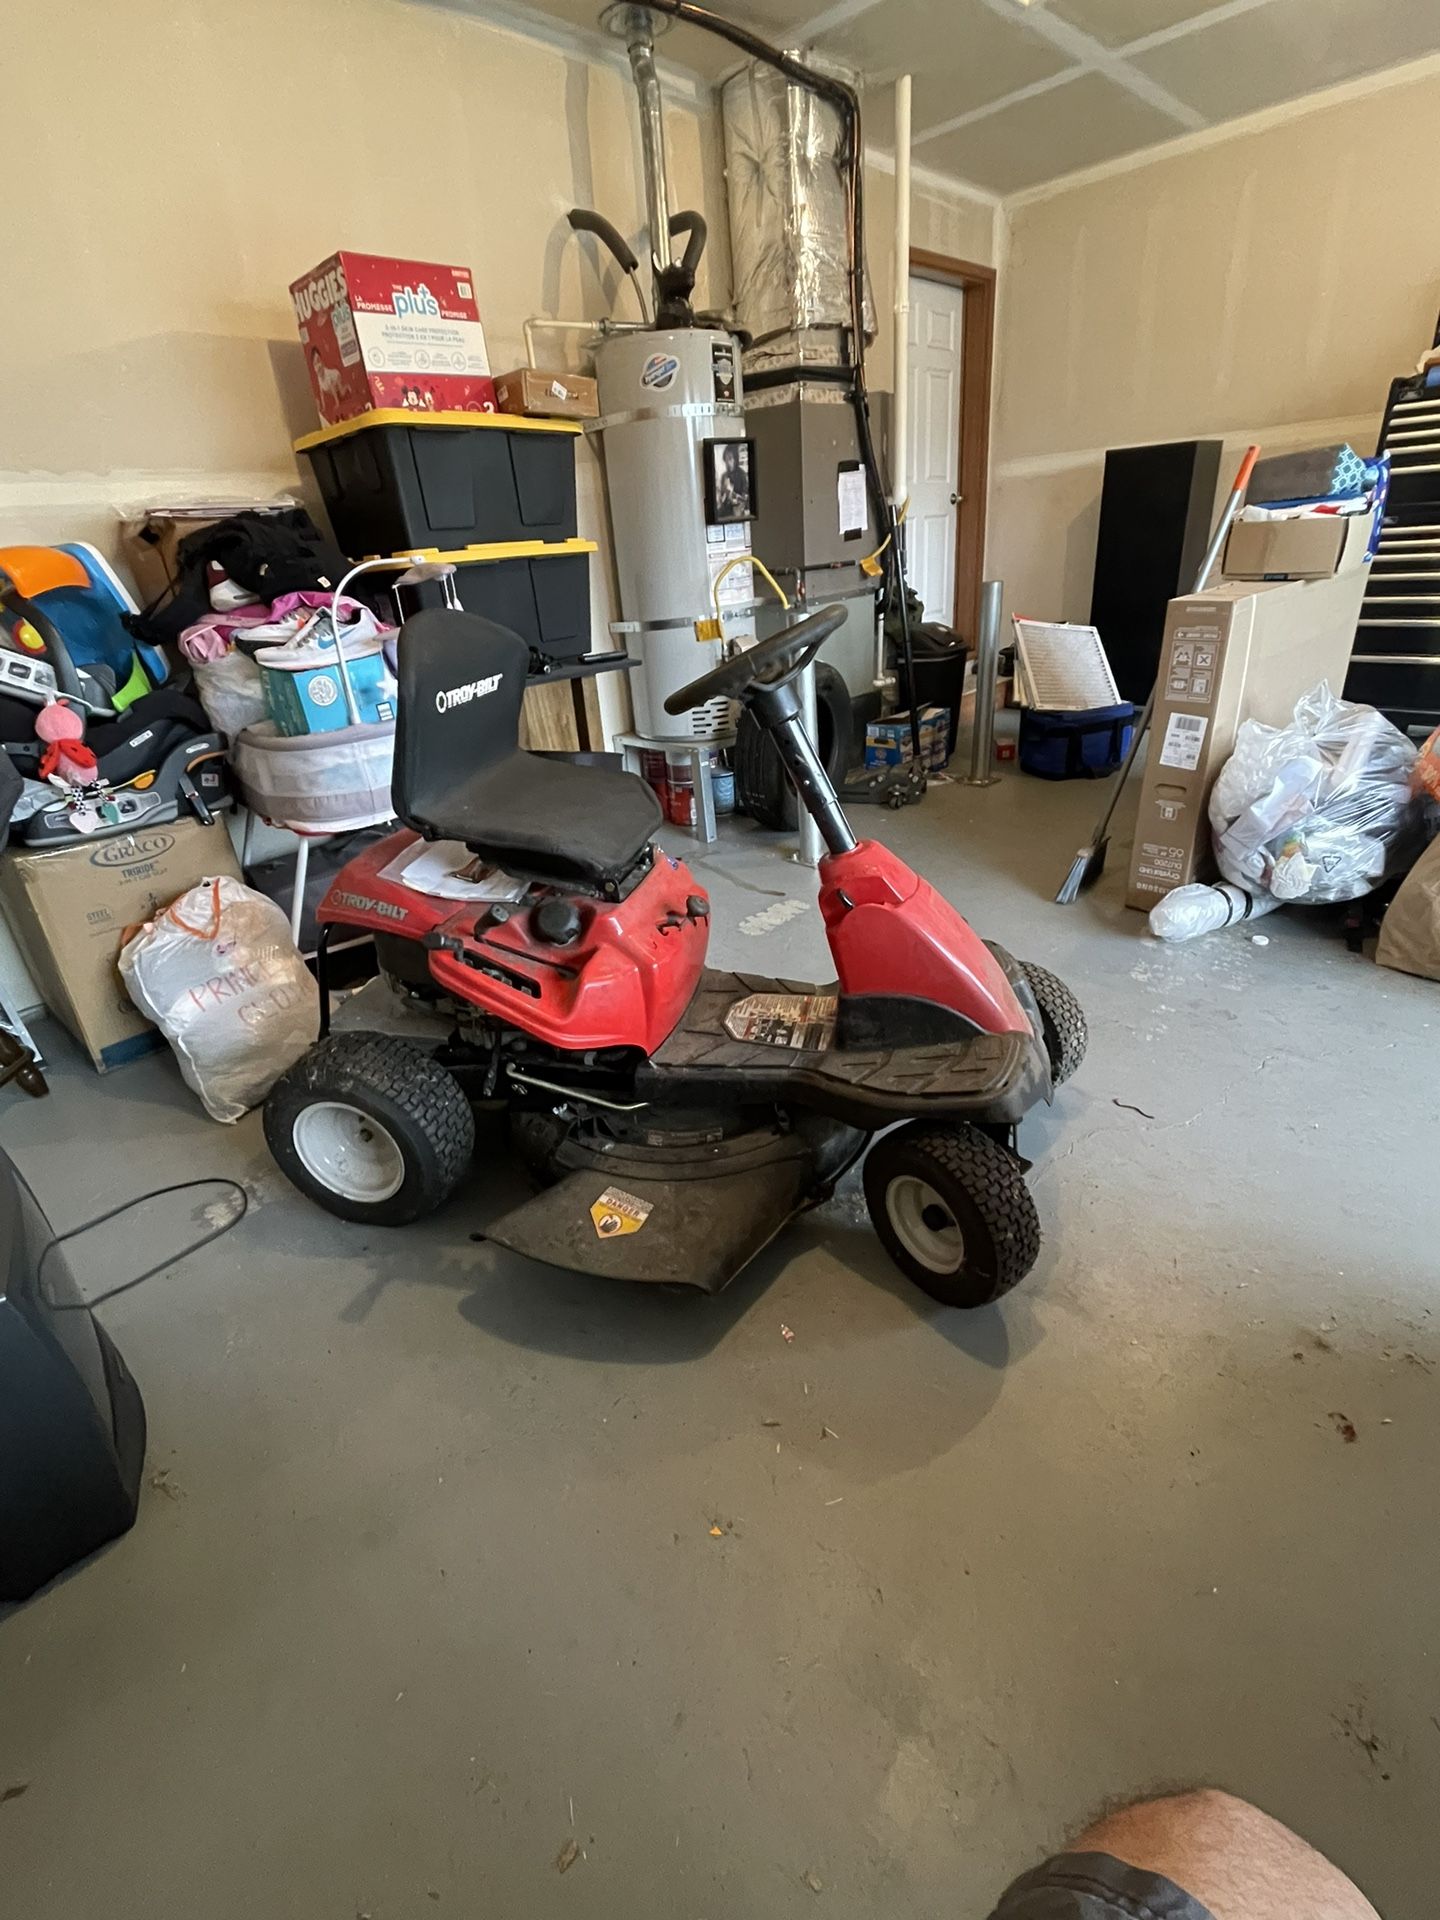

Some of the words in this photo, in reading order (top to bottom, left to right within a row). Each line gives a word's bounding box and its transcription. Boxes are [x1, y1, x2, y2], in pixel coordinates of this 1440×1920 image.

[295, 266, 348, 323] HUGGIES
[357, 302, 394, 313] PROMESSE
[441, 310, 468, 319] PROMISE
[446, 673, 503, 709] TROY-BILT
[103, 836, 167, 862] GRACO
[1168, 847, 1184, 858] 65
[342, 892, 409, 921] TROY-BILT
[606, 1198, 641, 1218] DANGER
